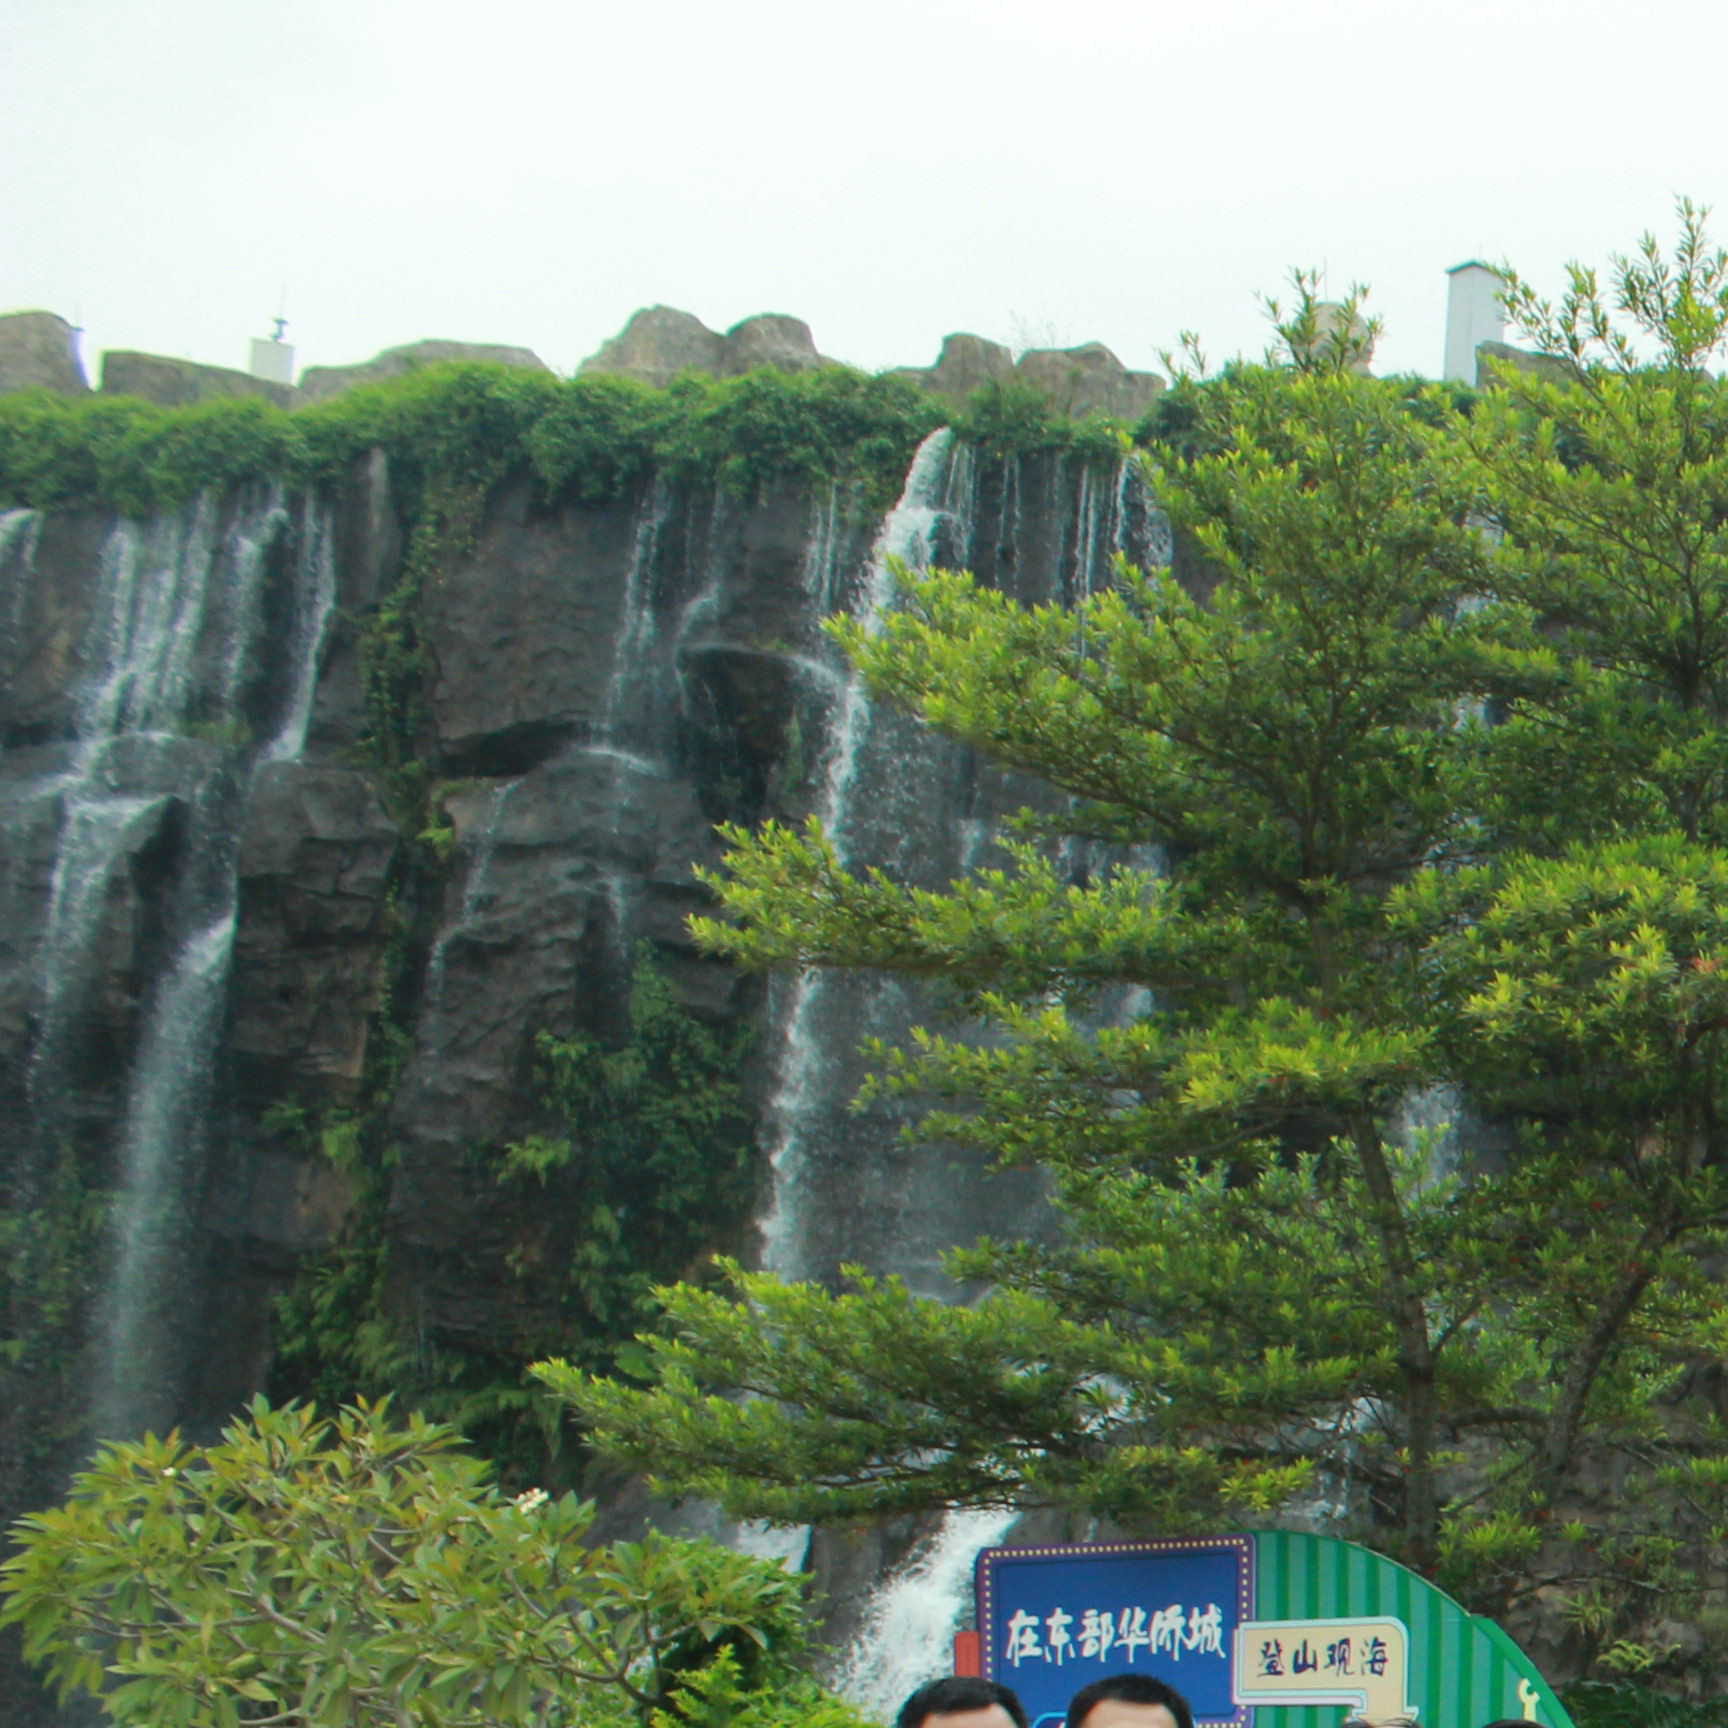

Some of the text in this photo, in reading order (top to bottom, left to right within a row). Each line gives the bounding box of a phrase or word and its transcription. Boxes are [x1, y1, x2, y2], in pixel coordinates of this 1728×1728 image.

[1005, 1602, 1227, 1668] 在东部华侨城
[1257, 1636, 1389, 1678] 登山观海
